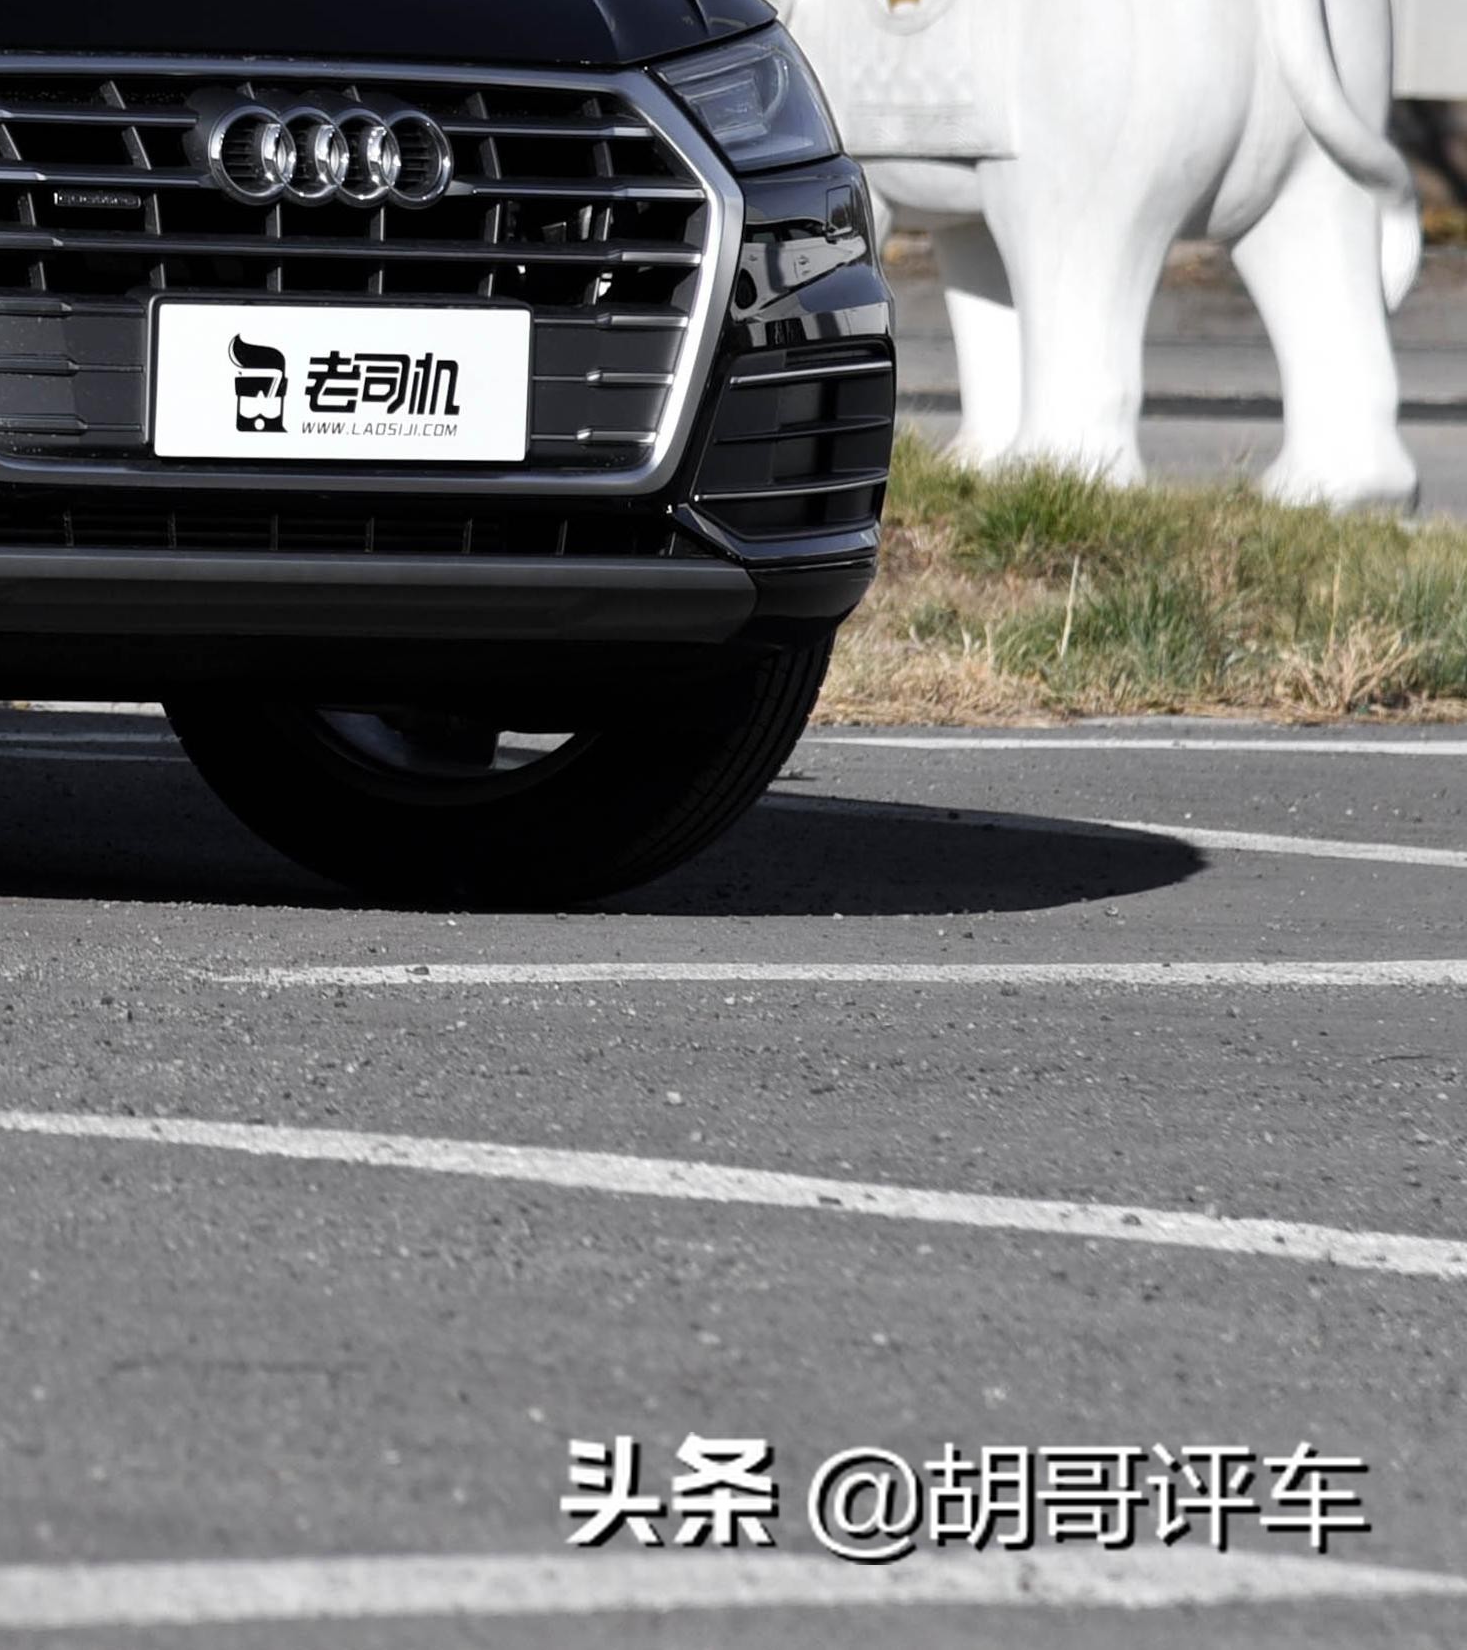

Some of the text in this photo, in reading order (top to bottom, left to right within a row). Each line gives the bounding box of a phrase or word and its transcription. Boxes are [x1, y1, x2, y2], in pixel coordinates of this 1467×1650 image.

[304, 350, 460, 416] 老司机
[301, 421, 458, 437] WWW.LAOSIJI.COM
